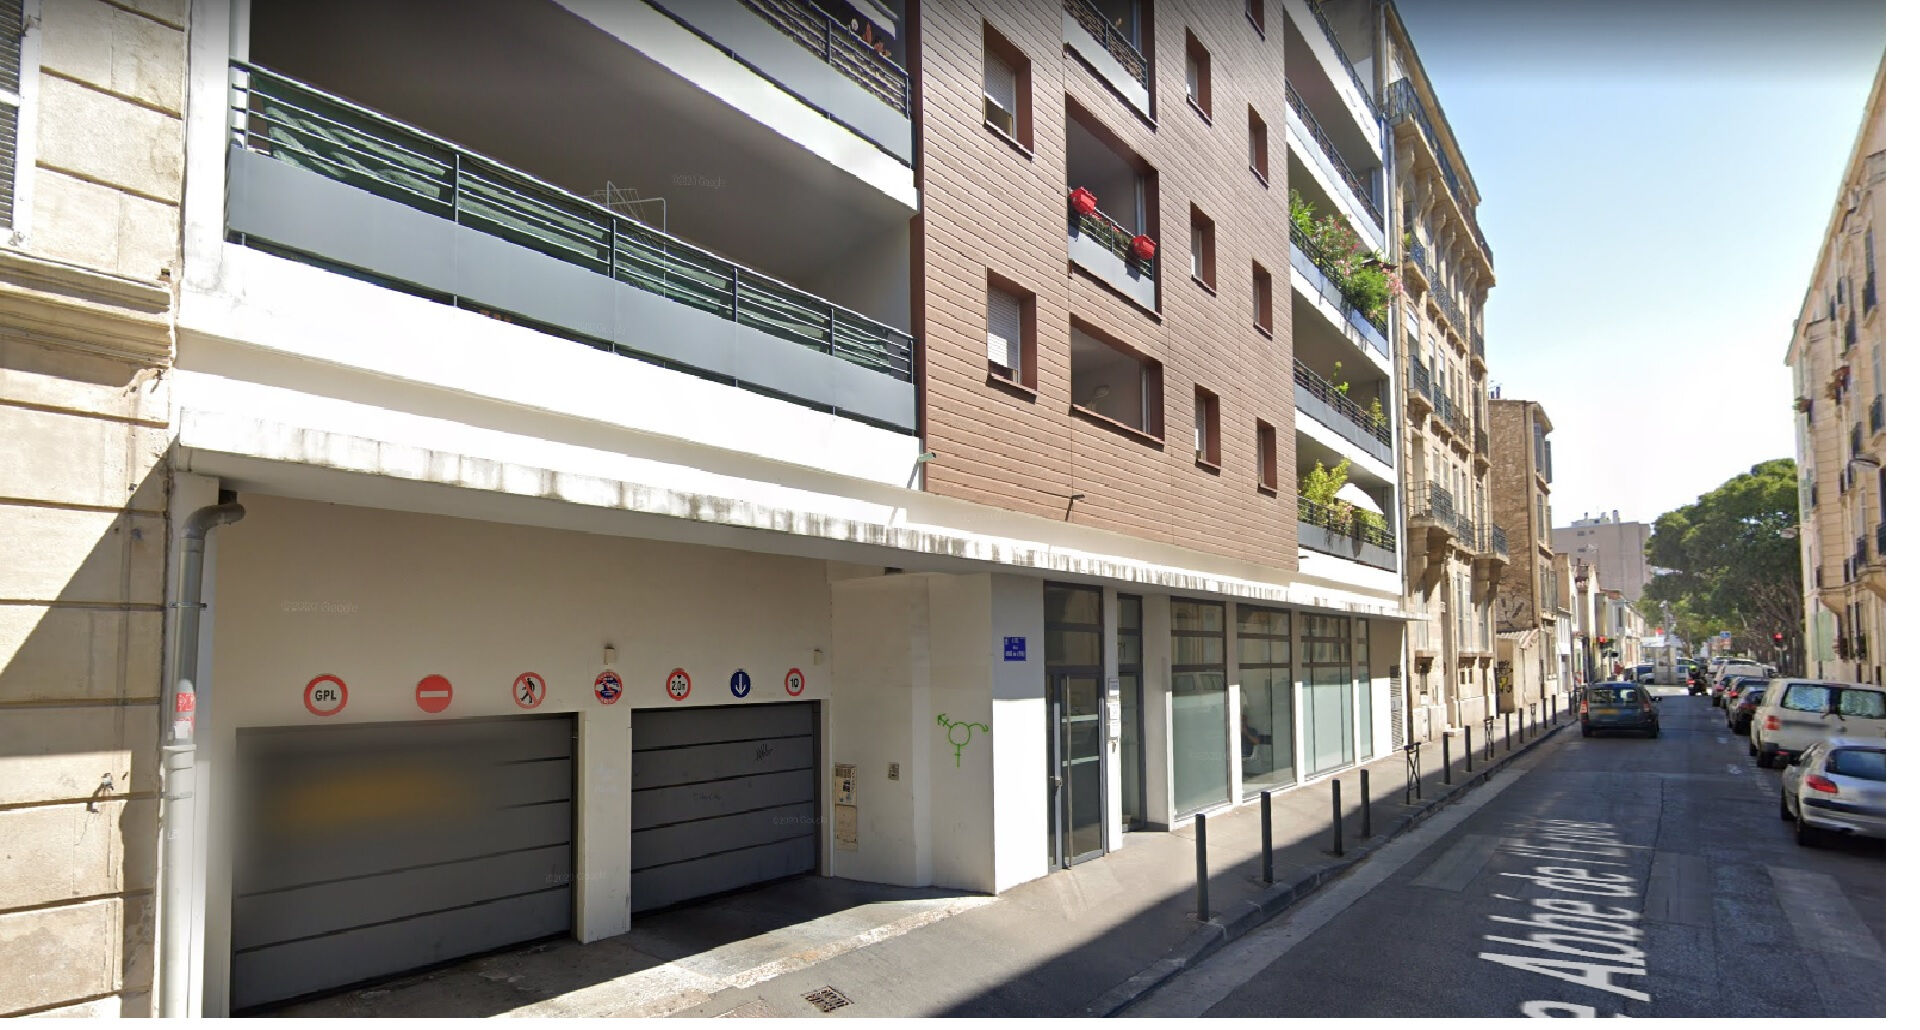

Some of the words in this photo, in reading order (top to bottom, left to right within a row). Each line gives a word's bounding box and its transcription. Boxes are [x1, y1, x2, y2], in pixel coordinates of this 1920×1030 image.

[789, 678, 800, 688] 10
[315, 689, 337, 702] GPL
[1500, 866, 1636, 898] de
[1477, 892, 1651, 1003] Abbé
